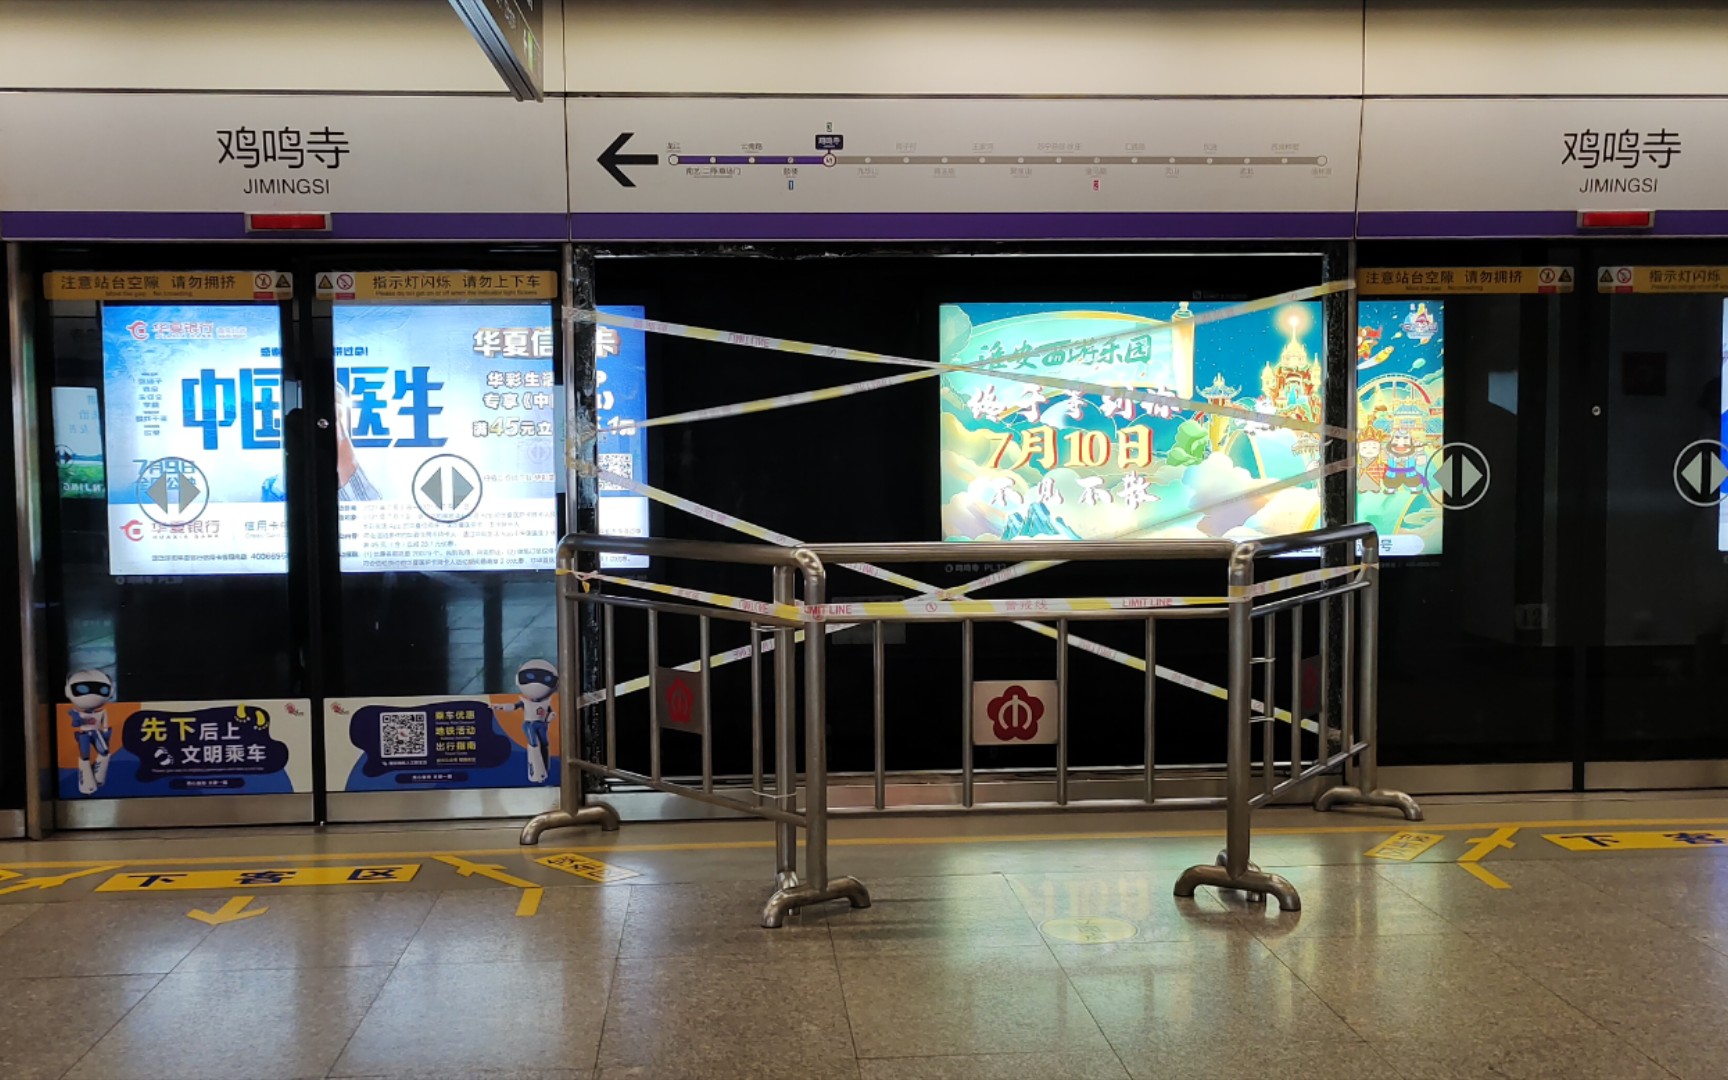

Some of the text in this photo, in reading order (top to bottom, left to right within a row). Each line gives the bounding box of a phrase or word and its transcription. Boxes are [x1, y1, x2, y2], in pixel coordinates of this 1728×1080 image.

[216, 126, 350, 168] 鸡鸣寺
[1561, 128, 1682, 169] 鸡鸣寺
[243, 178, 330, 195] JIMINGSI
[1579, 177, 1658, 193] JIMINGSI
[61, 275, 236, 290] 注意站台空隙 请勿拥挤
[373, 275, 541, 289] 指示灯闪烁 请勿上下车
[1365, 269, 1523, 284] 注意站台空隙 请勿拥挤
[1650, 269, 1721, 284] 指示灯闪烁
[154, 321, 213, 334] 华夏银行
[987, 424, 1154, 470] 7月10日
[991, 470, 1162, 509] 不见不散
[152, 520, 220, 533] 华夏银行
[829, 604, 852, 615] LINE
[1122, 597, 1173, 608] LIMIT LINE
[435, 710, 475, 720] 乘车优惠
[140, 717, 241, 742] 先下后上
[435, 726, 476, 736] 地铁活动
[181, 743, 267, 764] 文明乘车
[435, 741, 476, 751] 出行指南
[126, 867, 403, 888] 下客区
